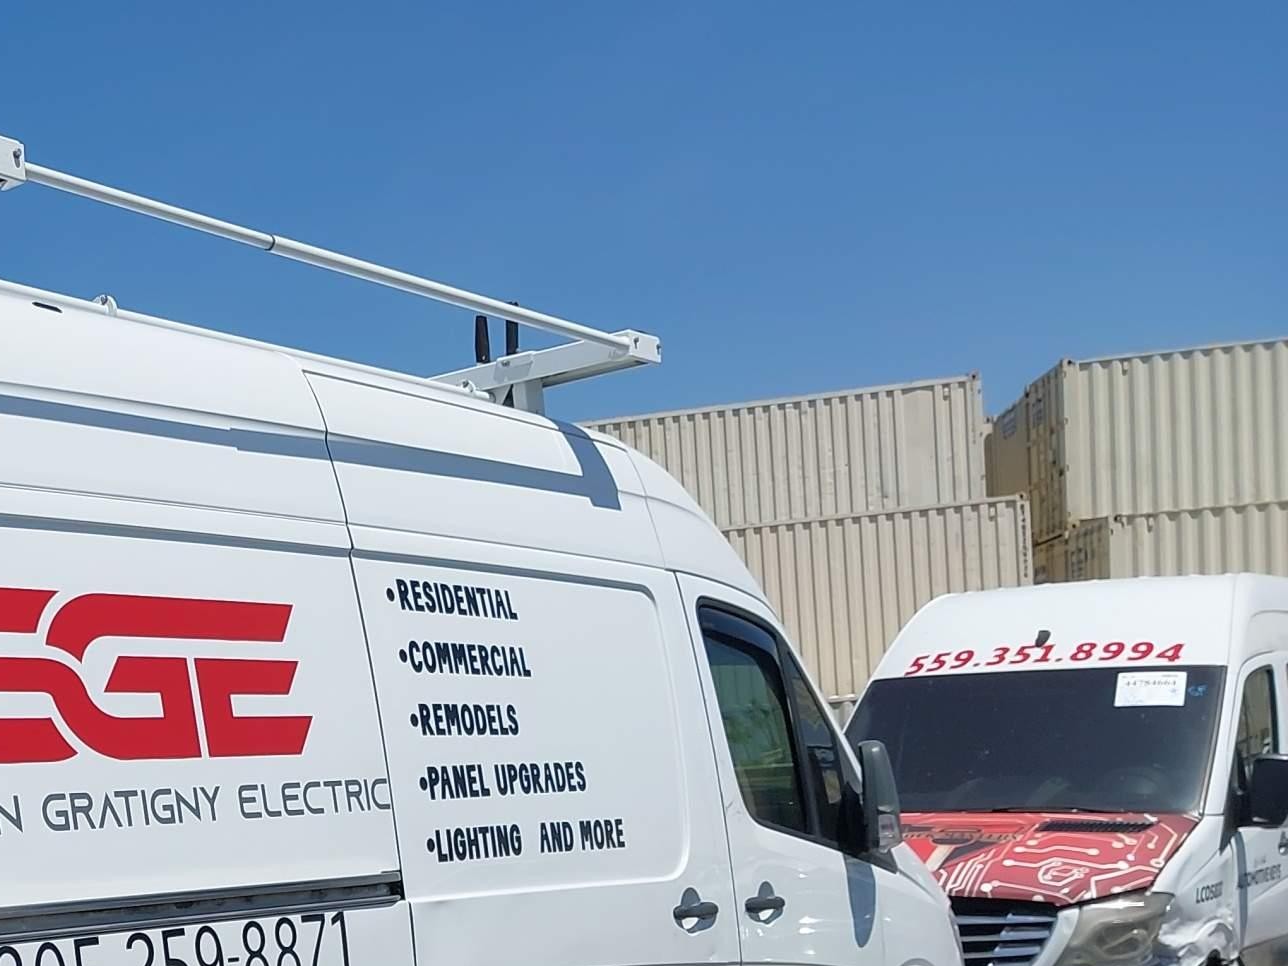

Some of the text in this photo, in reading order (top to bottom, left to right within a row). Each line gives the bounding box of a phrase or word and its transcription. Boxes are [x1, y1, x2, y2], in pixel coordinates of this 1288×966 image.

[396, 578, 518, 620] RESIDENTIAL
[408, 640, 531, 678] COMMERCIAL
[904, 642, 1184, 676] 559.351.8994
[418, 703, 519, 736] REMODELS
[426, 761, 587, 801] PANEL UPGRADES
[41, 785, 221, 831] GRATIGNY
[237, 777, 391, 819] ELECTRIC
[435, 819, 626, 863] LIGHTING AND MORE
